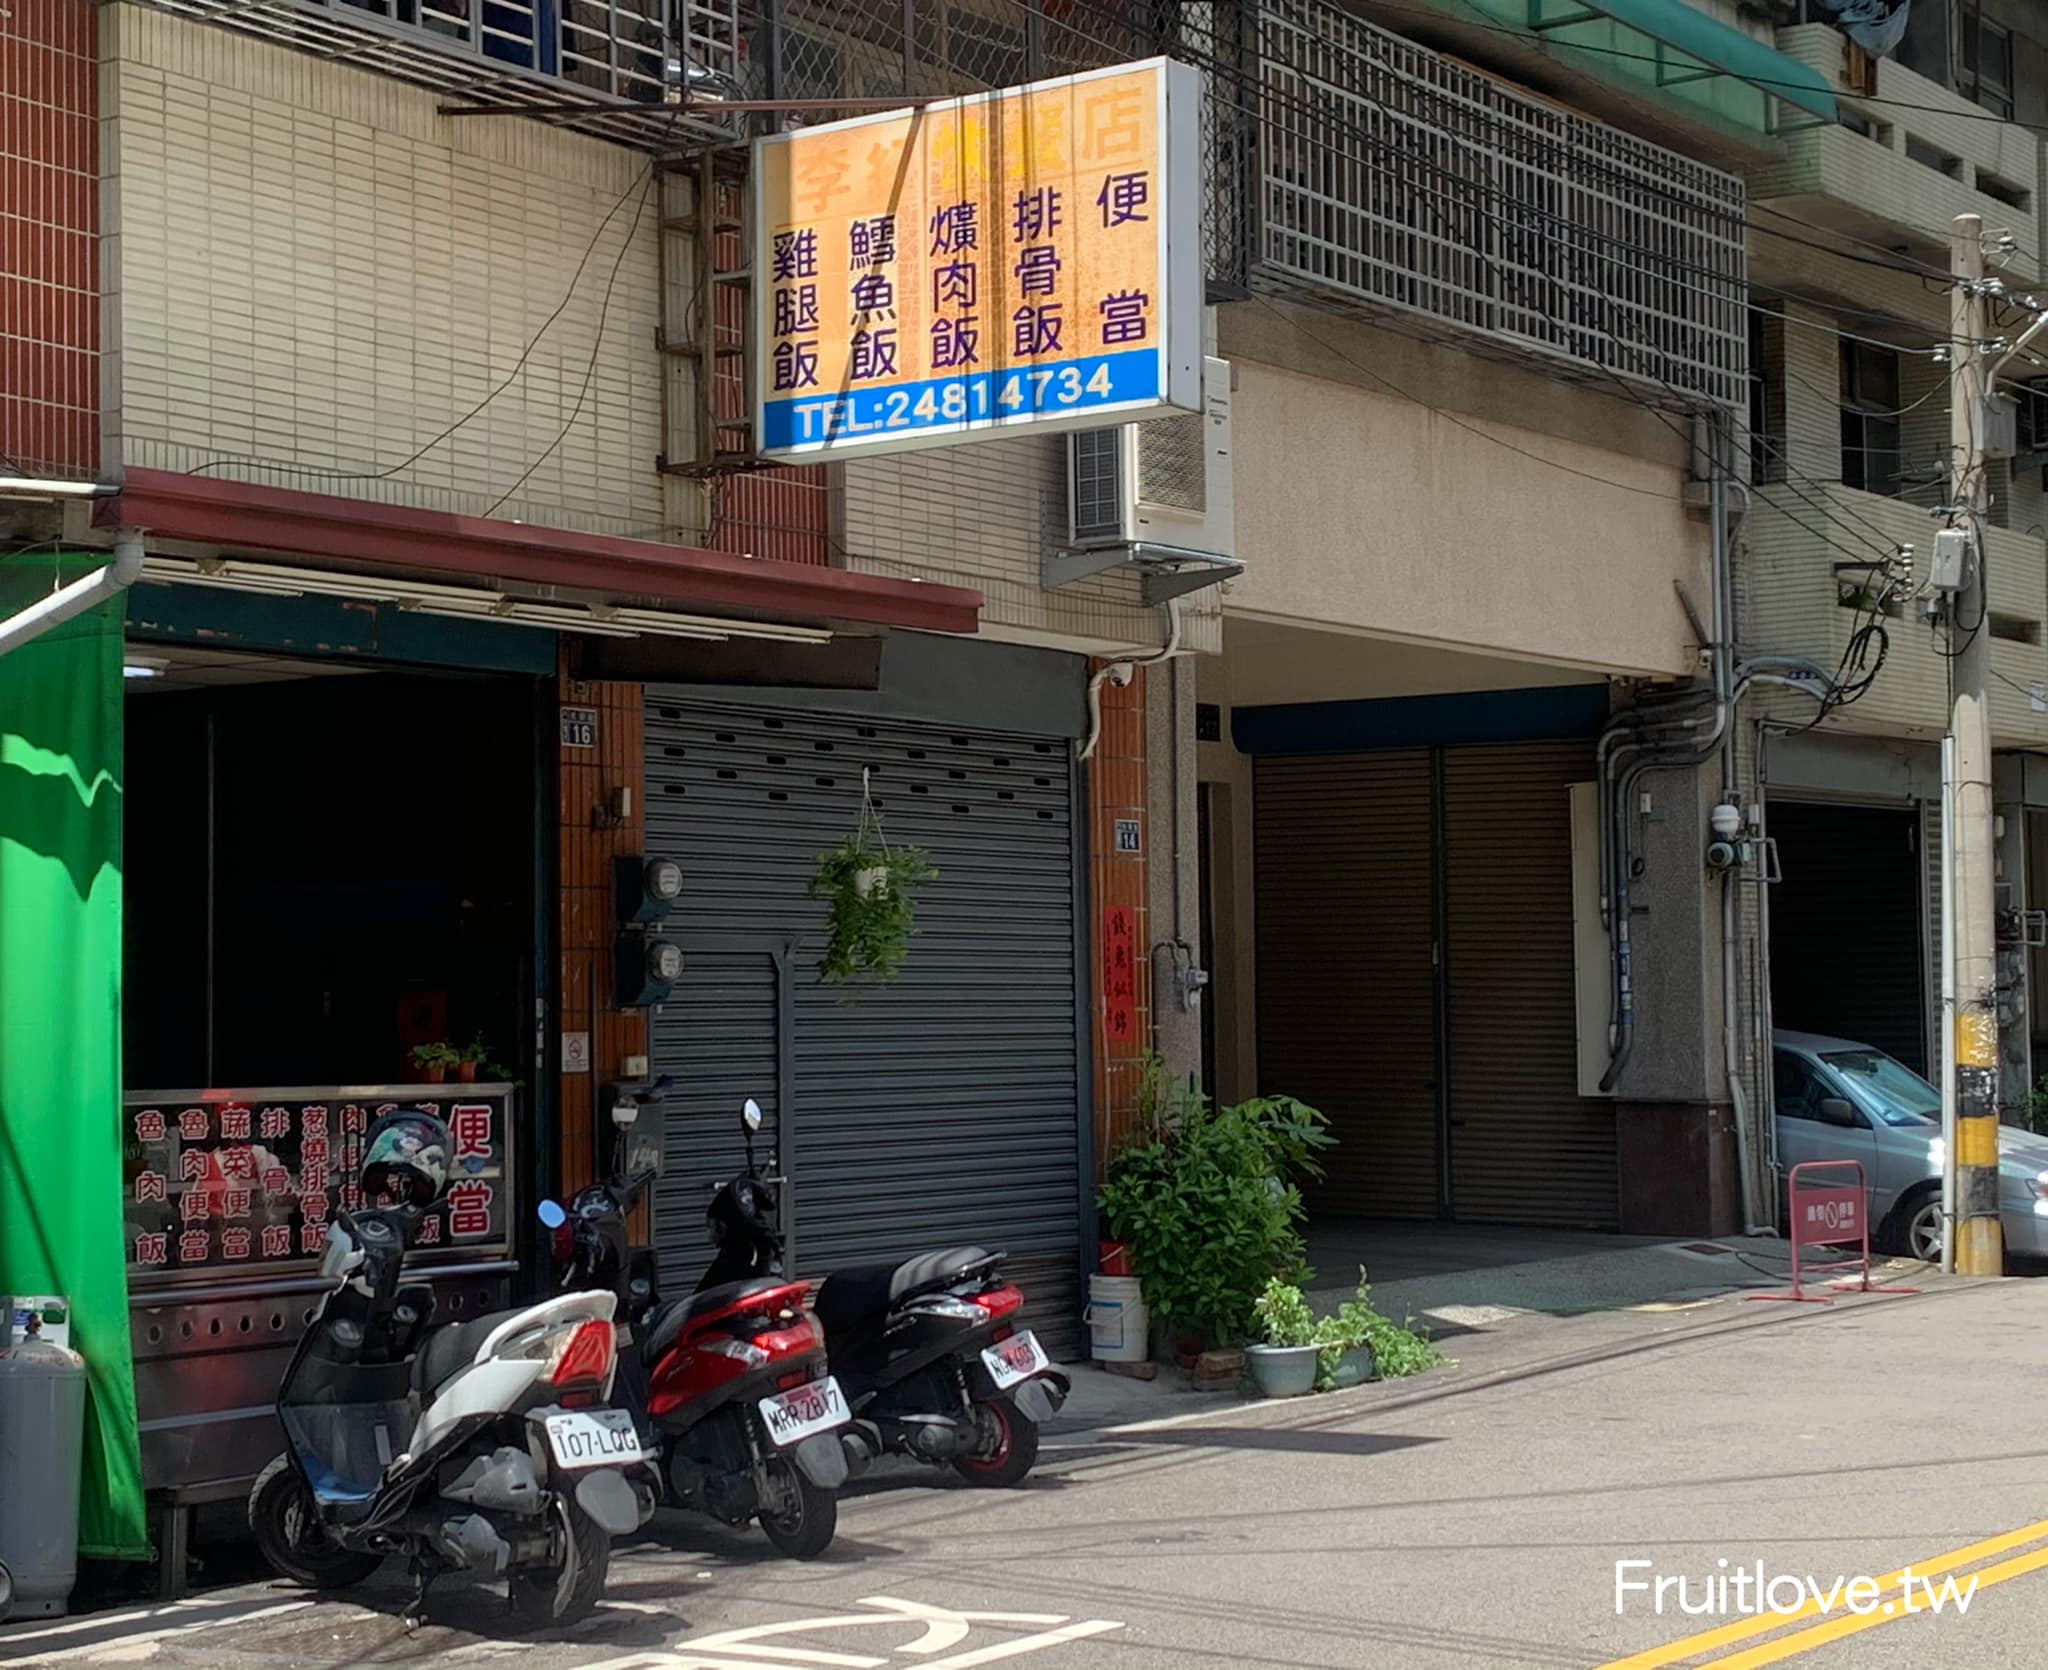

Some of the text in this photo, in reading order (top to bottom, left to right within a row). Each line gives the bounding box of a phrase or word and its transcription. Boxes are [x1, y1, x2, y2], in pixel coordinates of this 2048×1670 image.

[771, 228, 820, 391] 雞腿飯
[849, 215, 897, 381] 鱈魚飯
[929, 200, 979, 369] 爌肉飯
[1012, 185, 1063, 357] 排骨飯
[1096, 171, 1149, 345] 便當
[573, 723, 590, 744] 16
[134, 1109, 167, 1264] 魯肉飯
[178, 1108, 210, 1262] 魯肉便當
[220, 1107, 251, 1259] 蔬菜便當
[260, 1106, 291, 1257] 排骨飯
[448, 1103, 493, 1236] 便當
